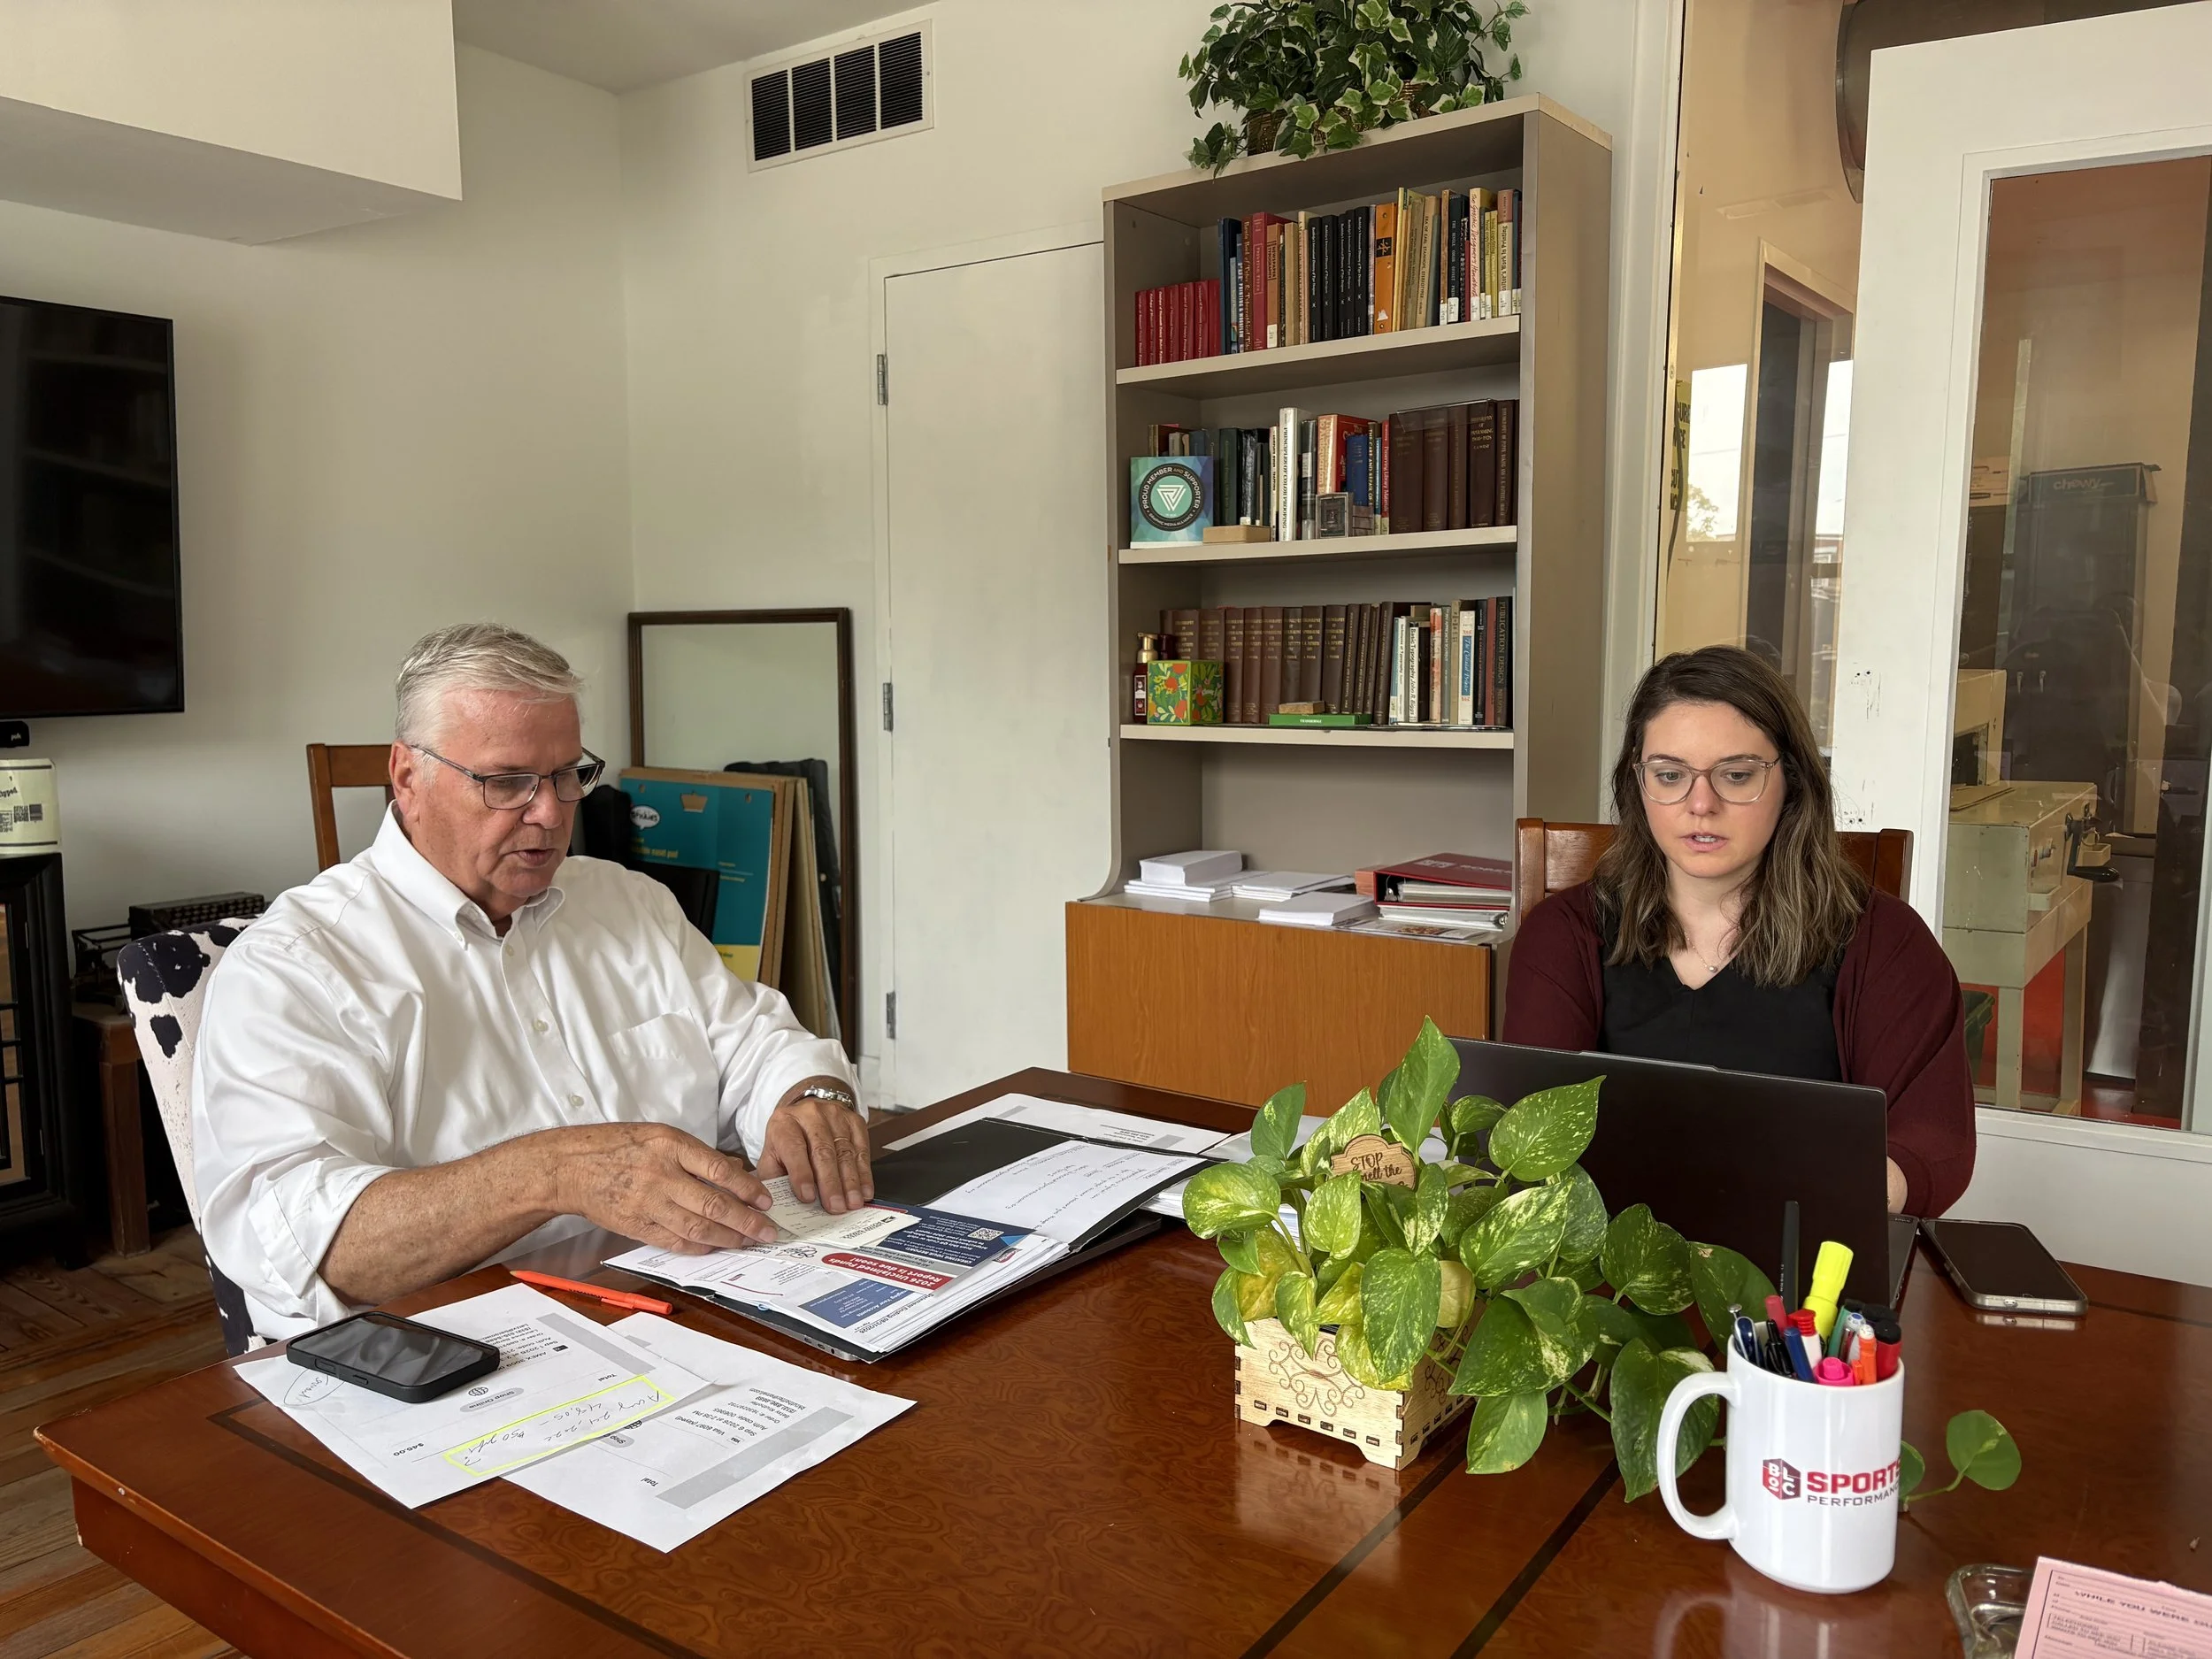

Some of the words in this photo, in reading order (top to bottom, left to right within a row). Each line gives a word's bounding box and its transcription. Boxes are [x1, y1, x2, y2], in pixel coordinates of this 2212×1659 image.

[1148, 467, 1172, 485] MEMBER
[1183, 471, 1201, 509] SUPPORTER
[2054, 478, 2101, 490] chewy
[1351, 1152, 1383, 1171] STOP
[1361, 1166, 1383, 1180] mell
[1384, 1164, 1402, 1177] the
[828, 1257, 858, 1270] Funds
[849, 1256, 879, 1267] soon!
[879, 1263, 896, 1271] due
[858, 1263, 909, 1281] Unclaimed
[910, 1269, 943, 1282] Report
[908, 1277, 936, 1287] 2026
[878, 1297, 892, 1307] Your
[906, 1294, 933, 1308] Statement
[856, 1303, 880, 1317] Accounts
[887, 1305, 908, 1319] Ending
[520, 1346, 539, 1356] 2026
[525, 1352, 547, 1361] AMEX
[505, 1357, 526, 1368] 3009
[598, 1372, 616, 1382] Total
[495, 1390, 515, 1399] Shop
[469, 1398, 494, 1409] Online
[723, 1418, 739, 1428] 2026
[737, 1415, 753, 1425] code:
[765, 1416, 780, 1425] Order
[712, 1427, 726, 1436] Visa
[744, 1427, 757, 1436] Sep
[752, 1421, 768, 1431] Auth
[640, 1477, 659, 1487] Total
[1808, 1482, 1899, 1507] PERFORMANC
[2074, 1590, 2116, 1604] WHILE
[2119, 1601, 2146, 1611] YOU
[2150, 1607, 2189, 1623] WERE
